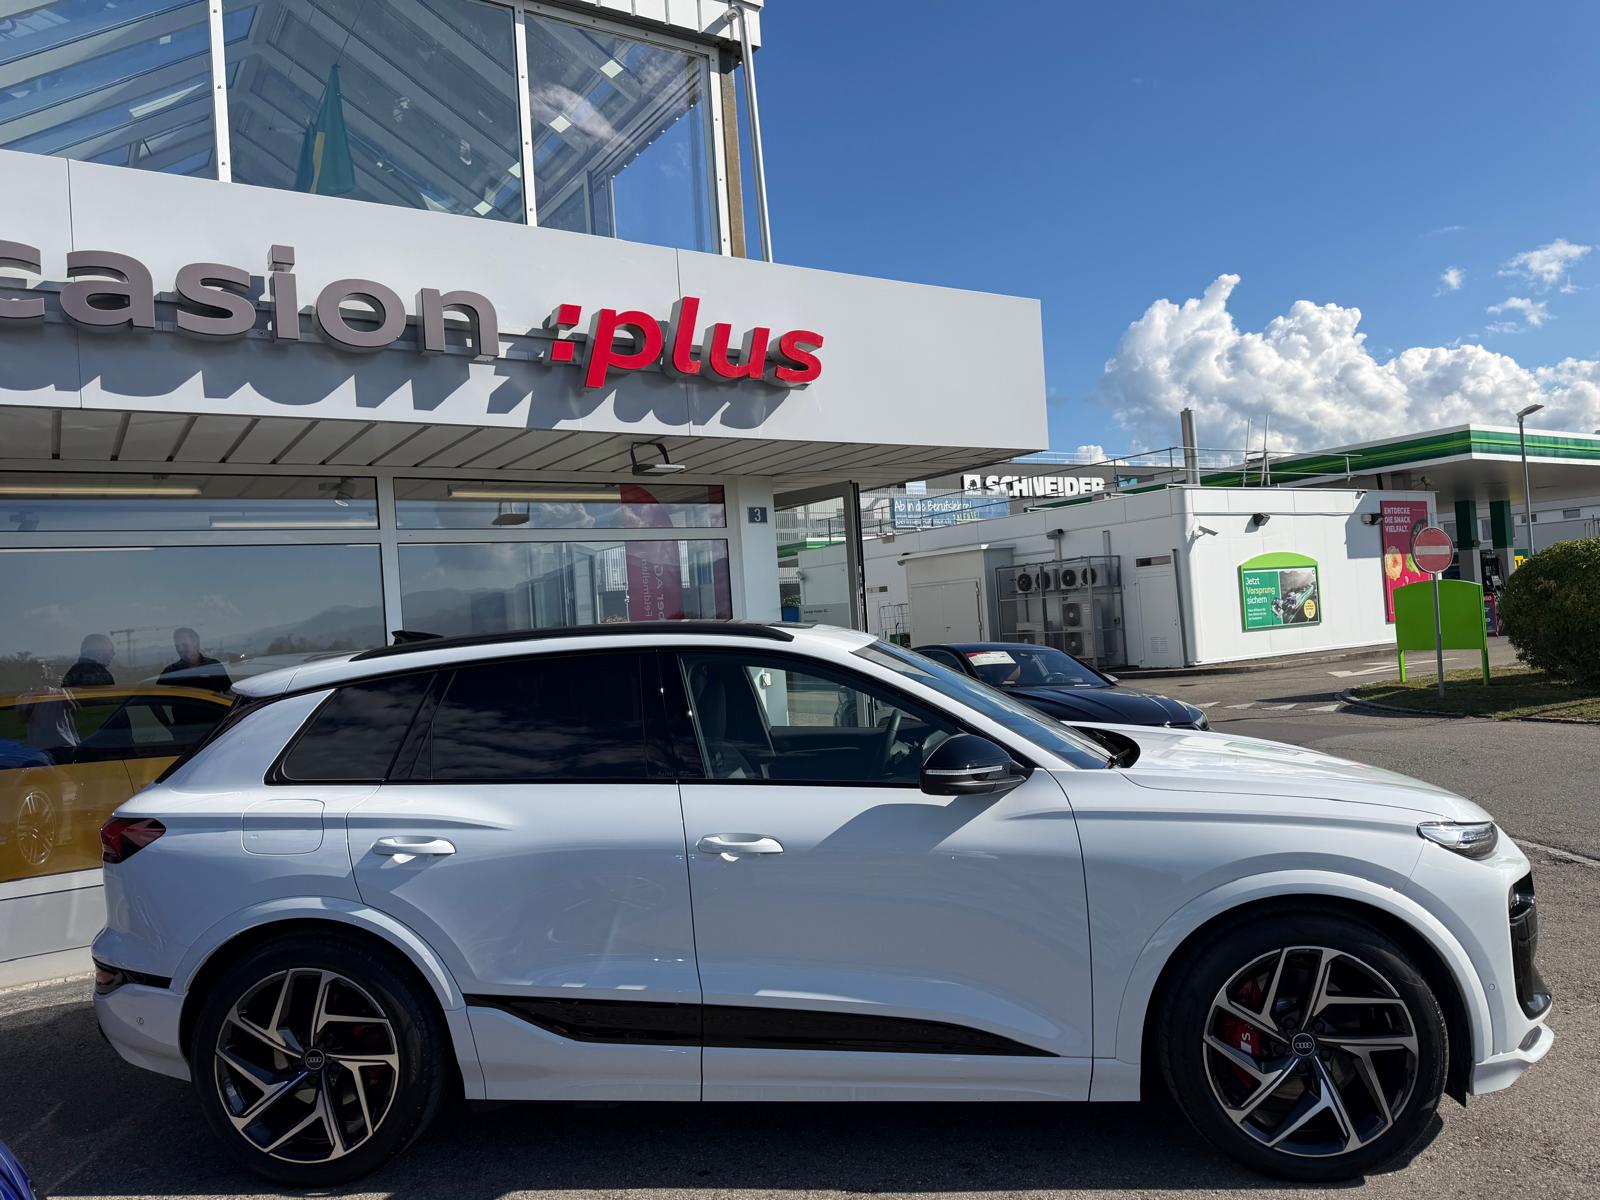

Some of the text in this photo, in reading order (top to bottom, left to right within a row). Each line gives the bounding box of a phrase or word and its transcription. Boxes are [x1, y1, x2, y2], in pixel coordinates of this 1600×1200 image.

[985, 475, 1105, 497] SCHNEIDER
[895, 500, 905, 512] Ab
[916, 500, 926, 512] de
[754, 508, 761, 522] 3
[1384, 507, 1410, 515] ENTDECKE
[1384, 516, 1411, 524] DIE SNACK
[1246, 577, 1260, 585] Jetzt
[1246, 586, 1276, 596] Vorsprung
[1247, 596, 1268, 605] sichern
